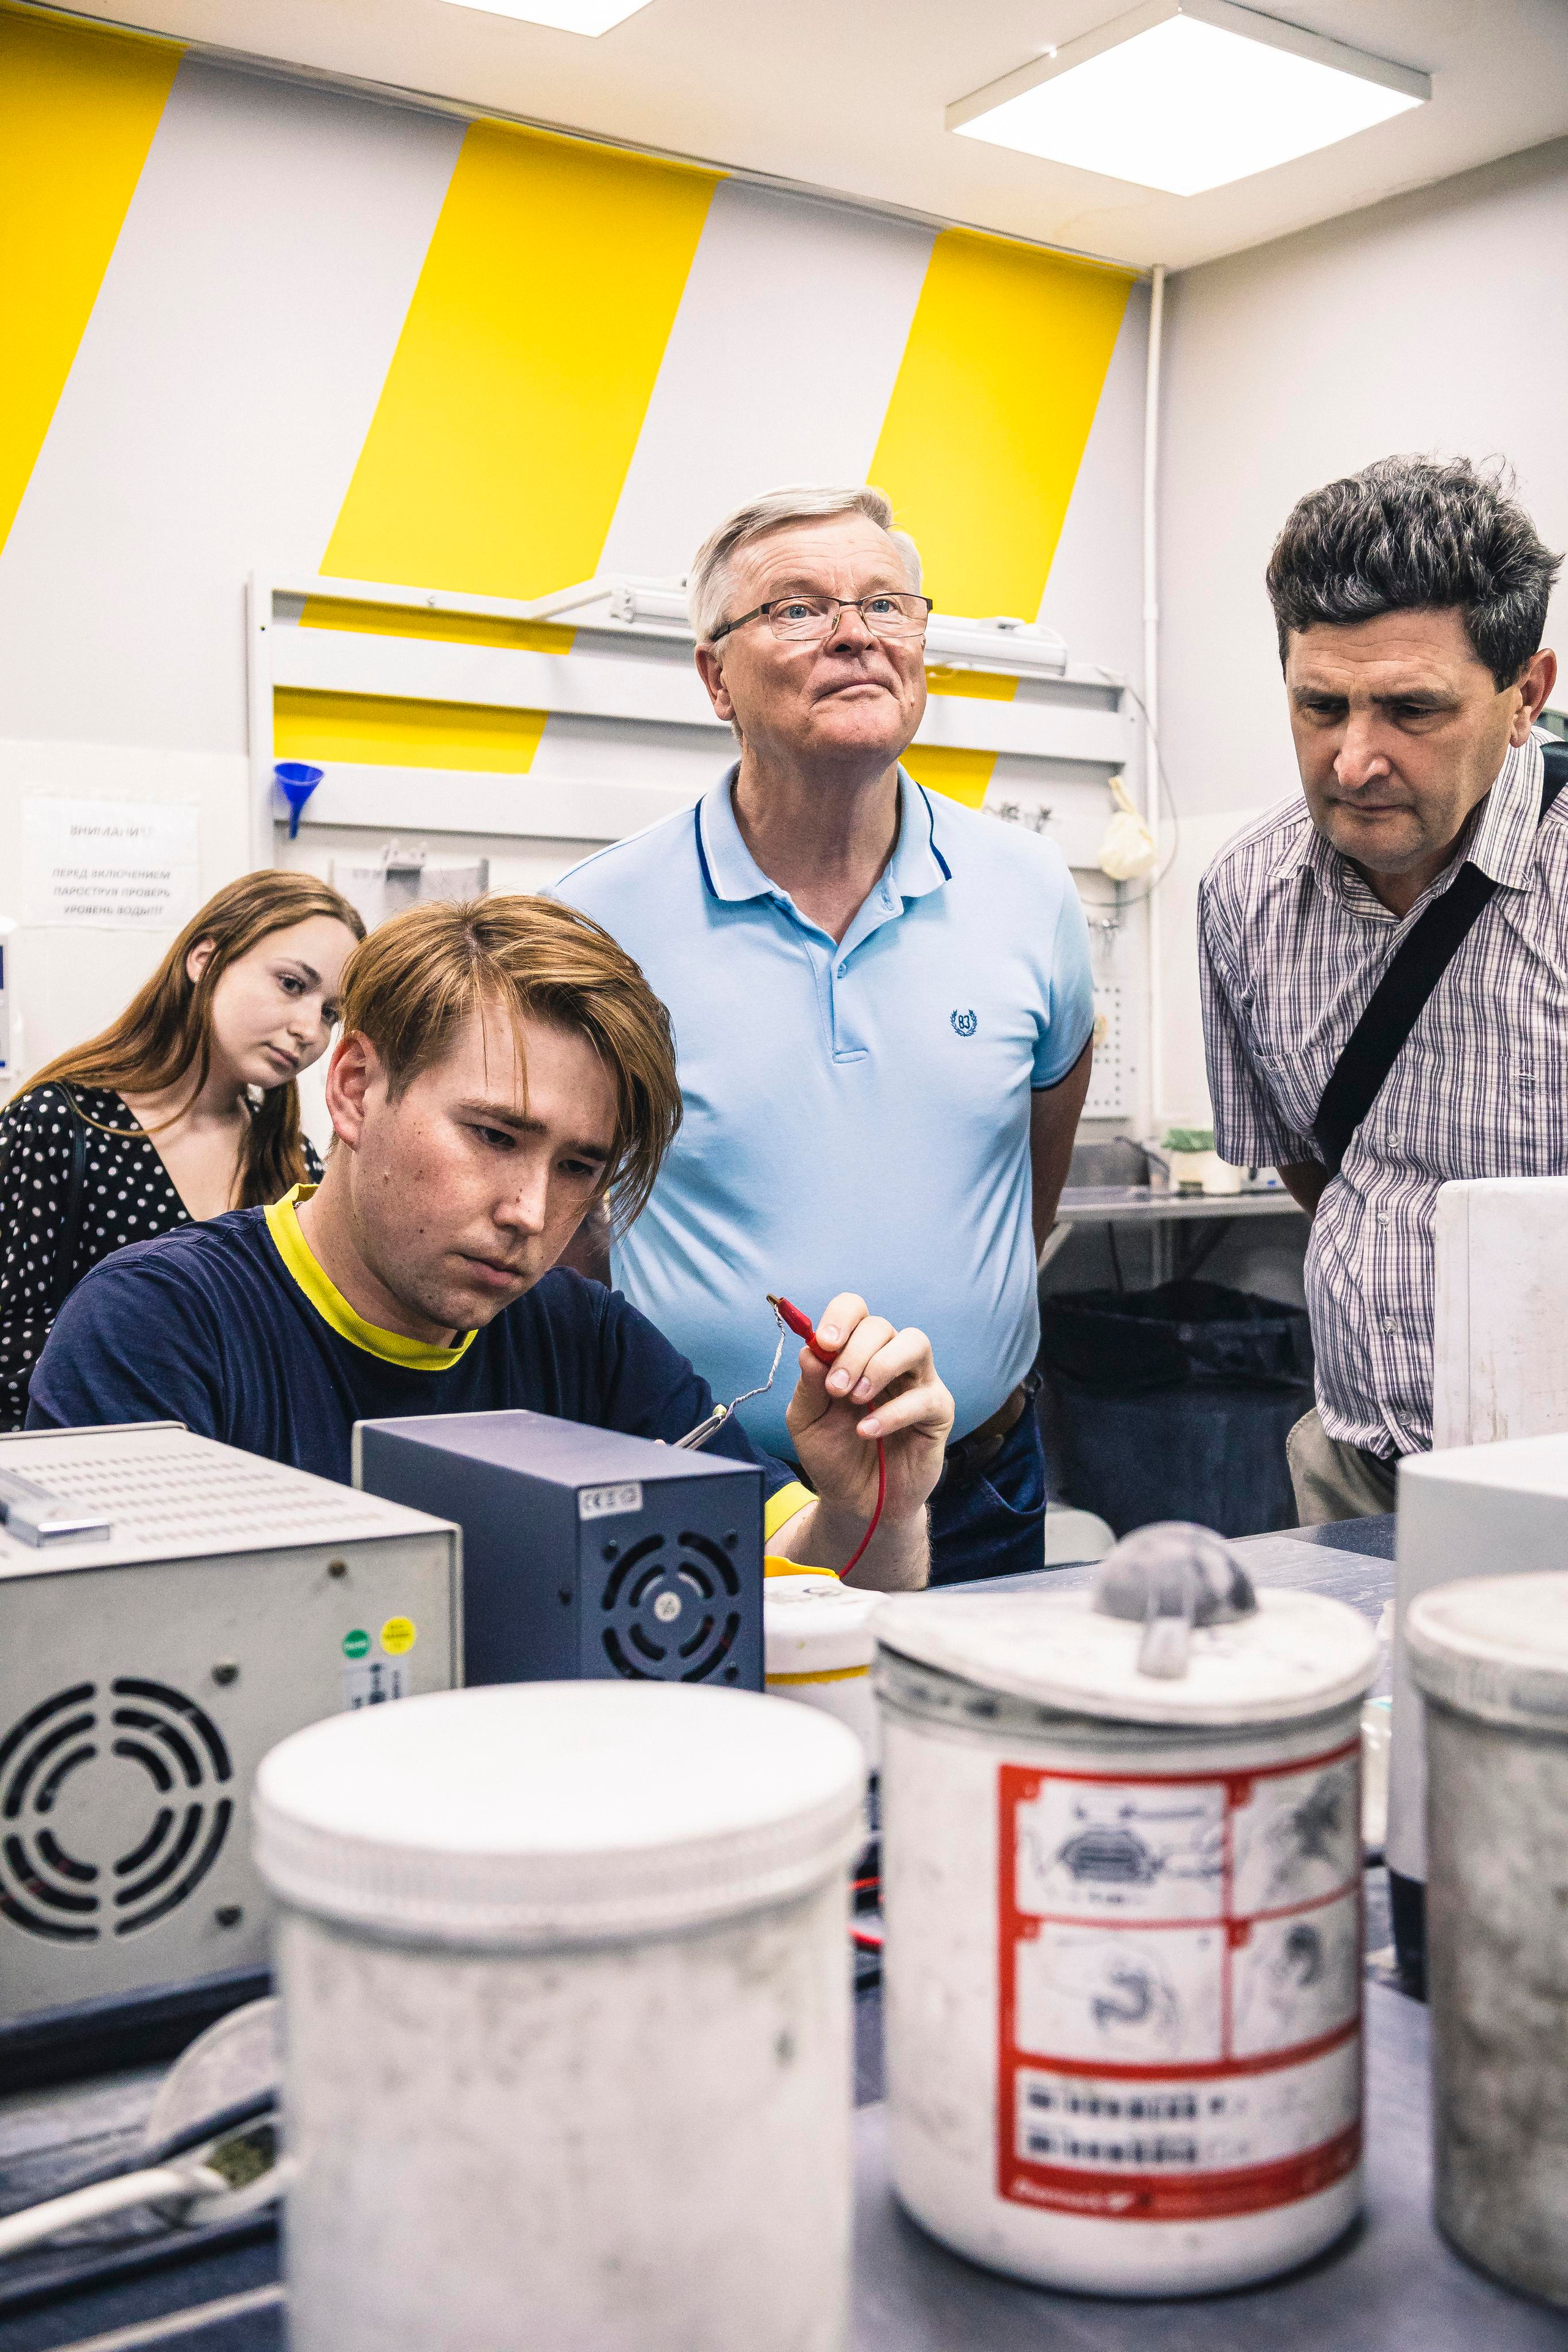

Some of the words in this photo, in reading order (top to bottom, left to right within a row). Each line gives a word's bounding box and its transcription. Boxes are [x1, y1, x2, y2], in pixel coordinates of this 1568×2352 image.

[52, 869, 88, 880] ПЕРЕД
[91, 869, 171, 880] ВКЛЮЧЕНИЕМ
[121, 887, 170, 897] ПРОВЕРЬ
[64, 905, 113, 916] УРОВЕНЬ
[958, 1015, 970, 1029] 83
